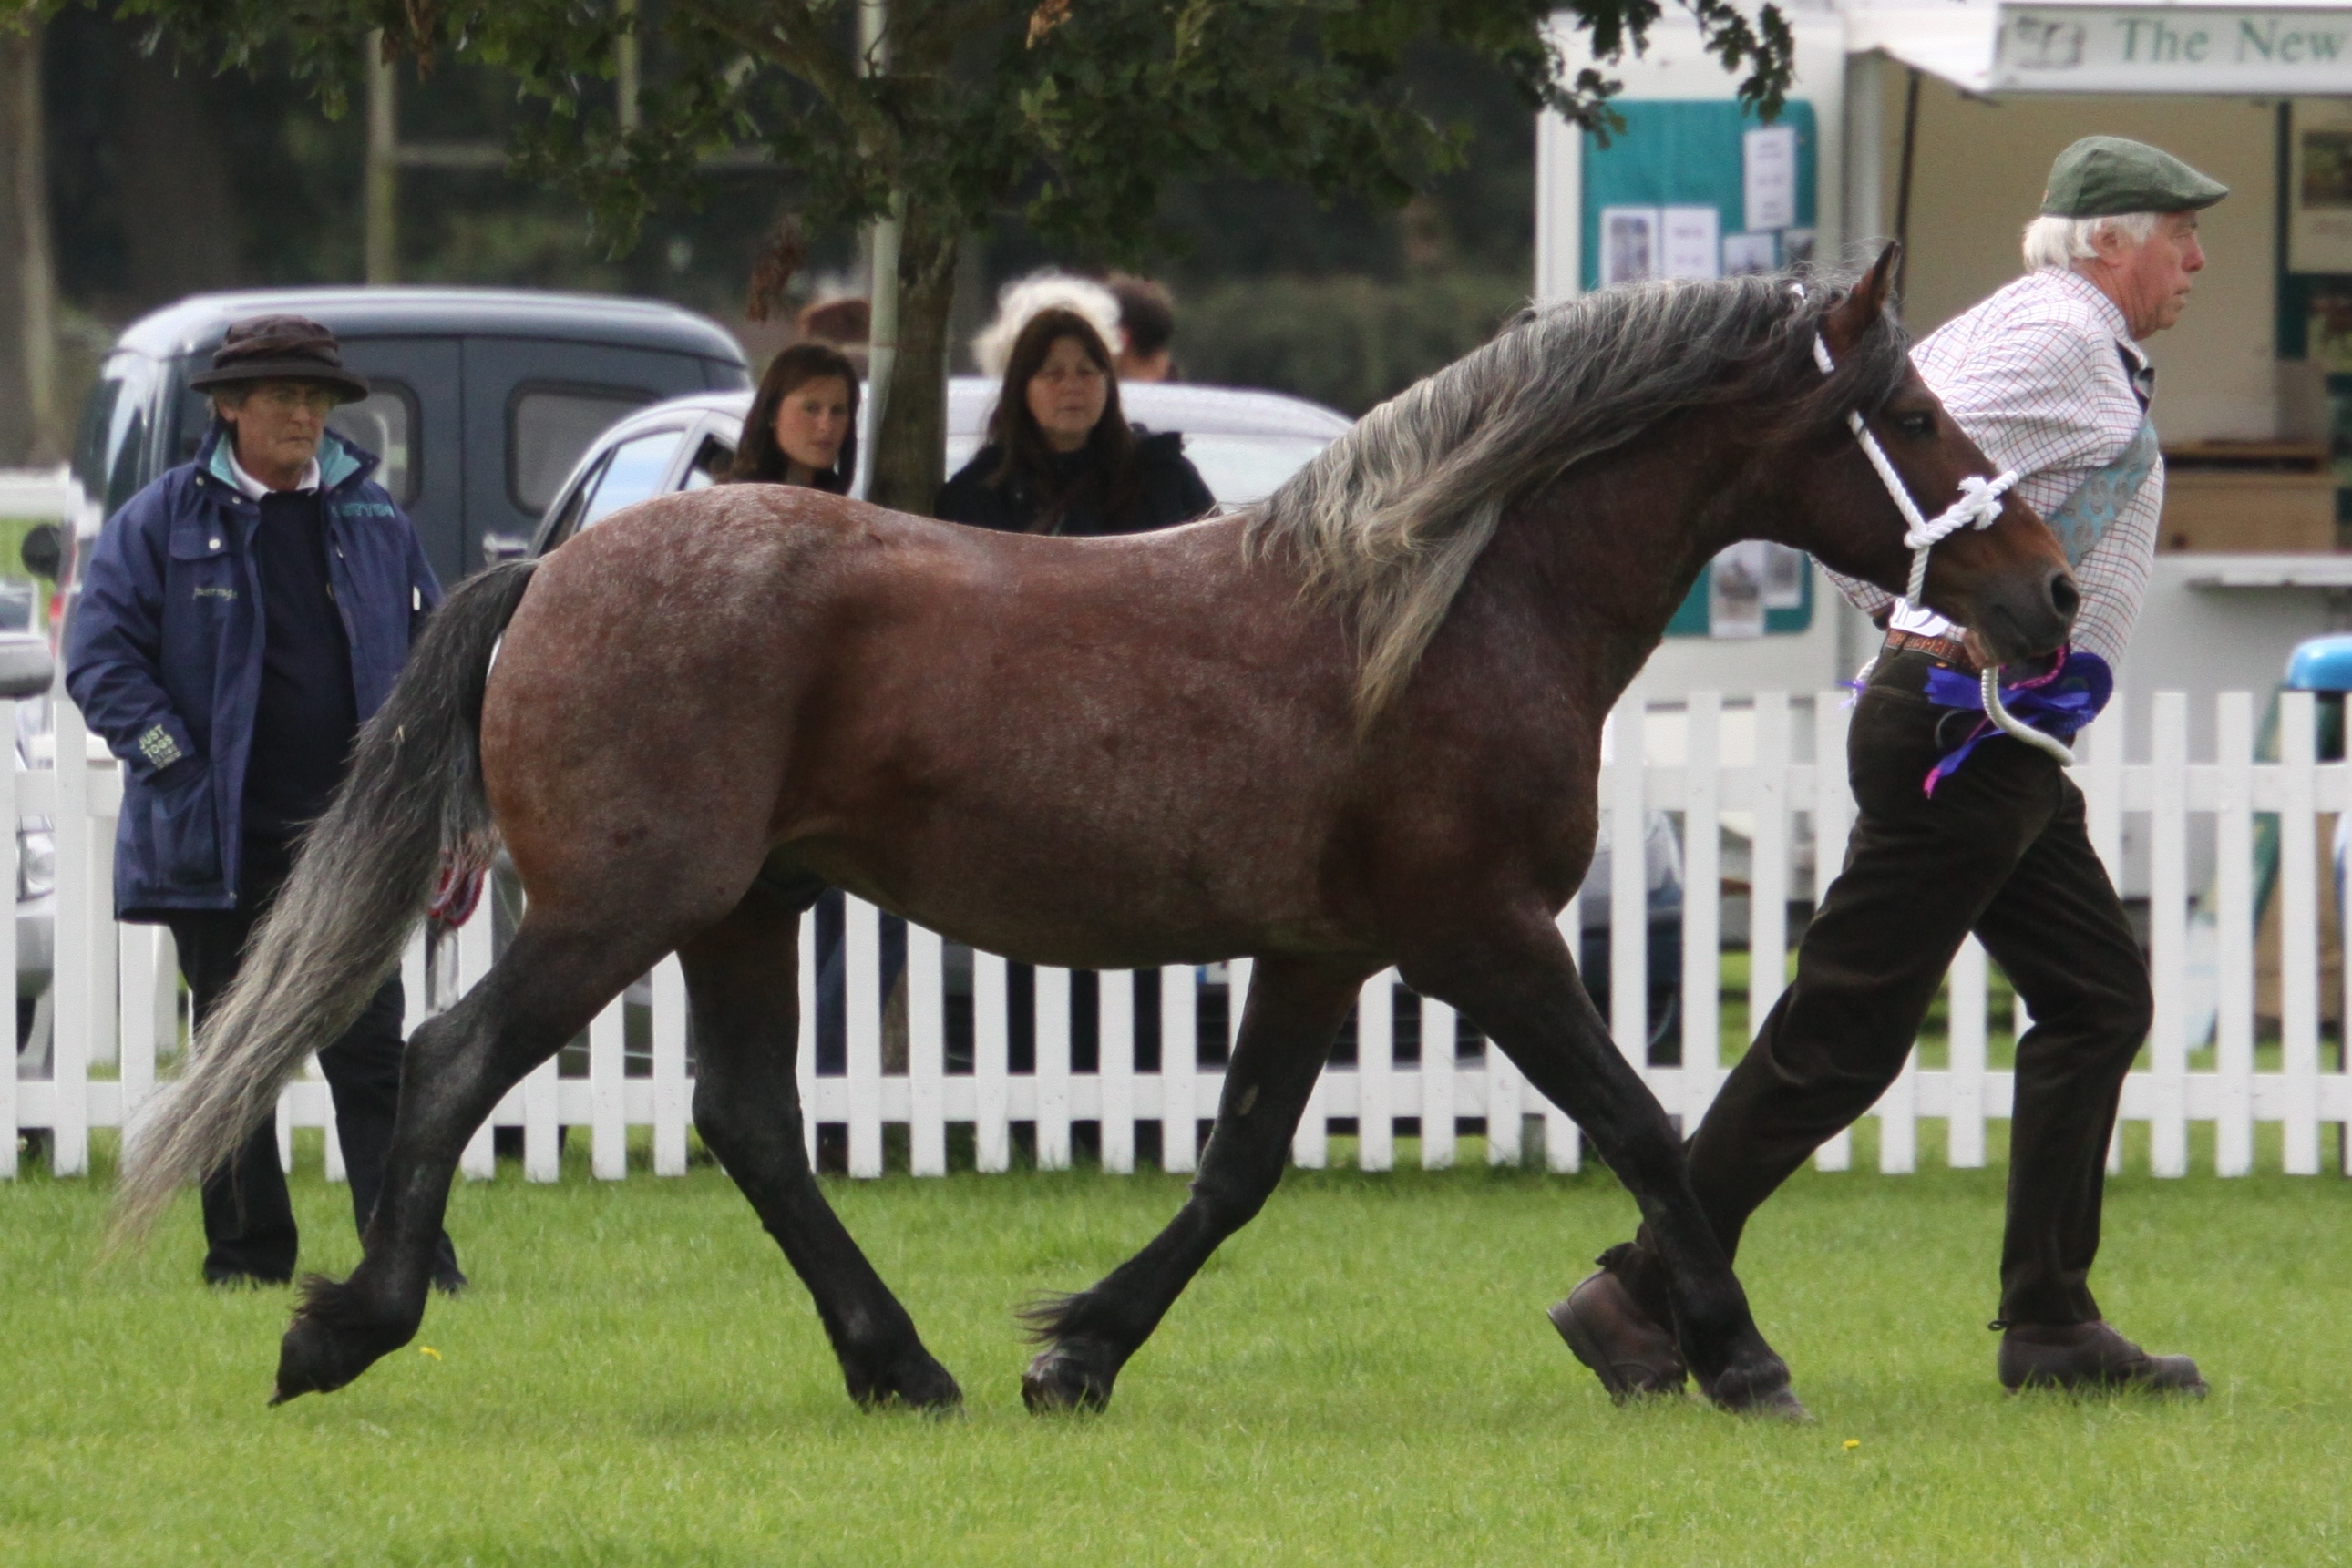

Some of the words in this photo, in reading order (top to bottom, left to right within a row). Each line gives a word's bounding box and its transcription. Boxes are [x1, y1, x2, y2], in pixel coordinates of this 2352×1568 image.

[2113, 17, 2209, 63] The
[2235, 17, 2346, 63] New
[139, 724, 164, 750] JUST
[143, 735, 173, 759] TOGS
